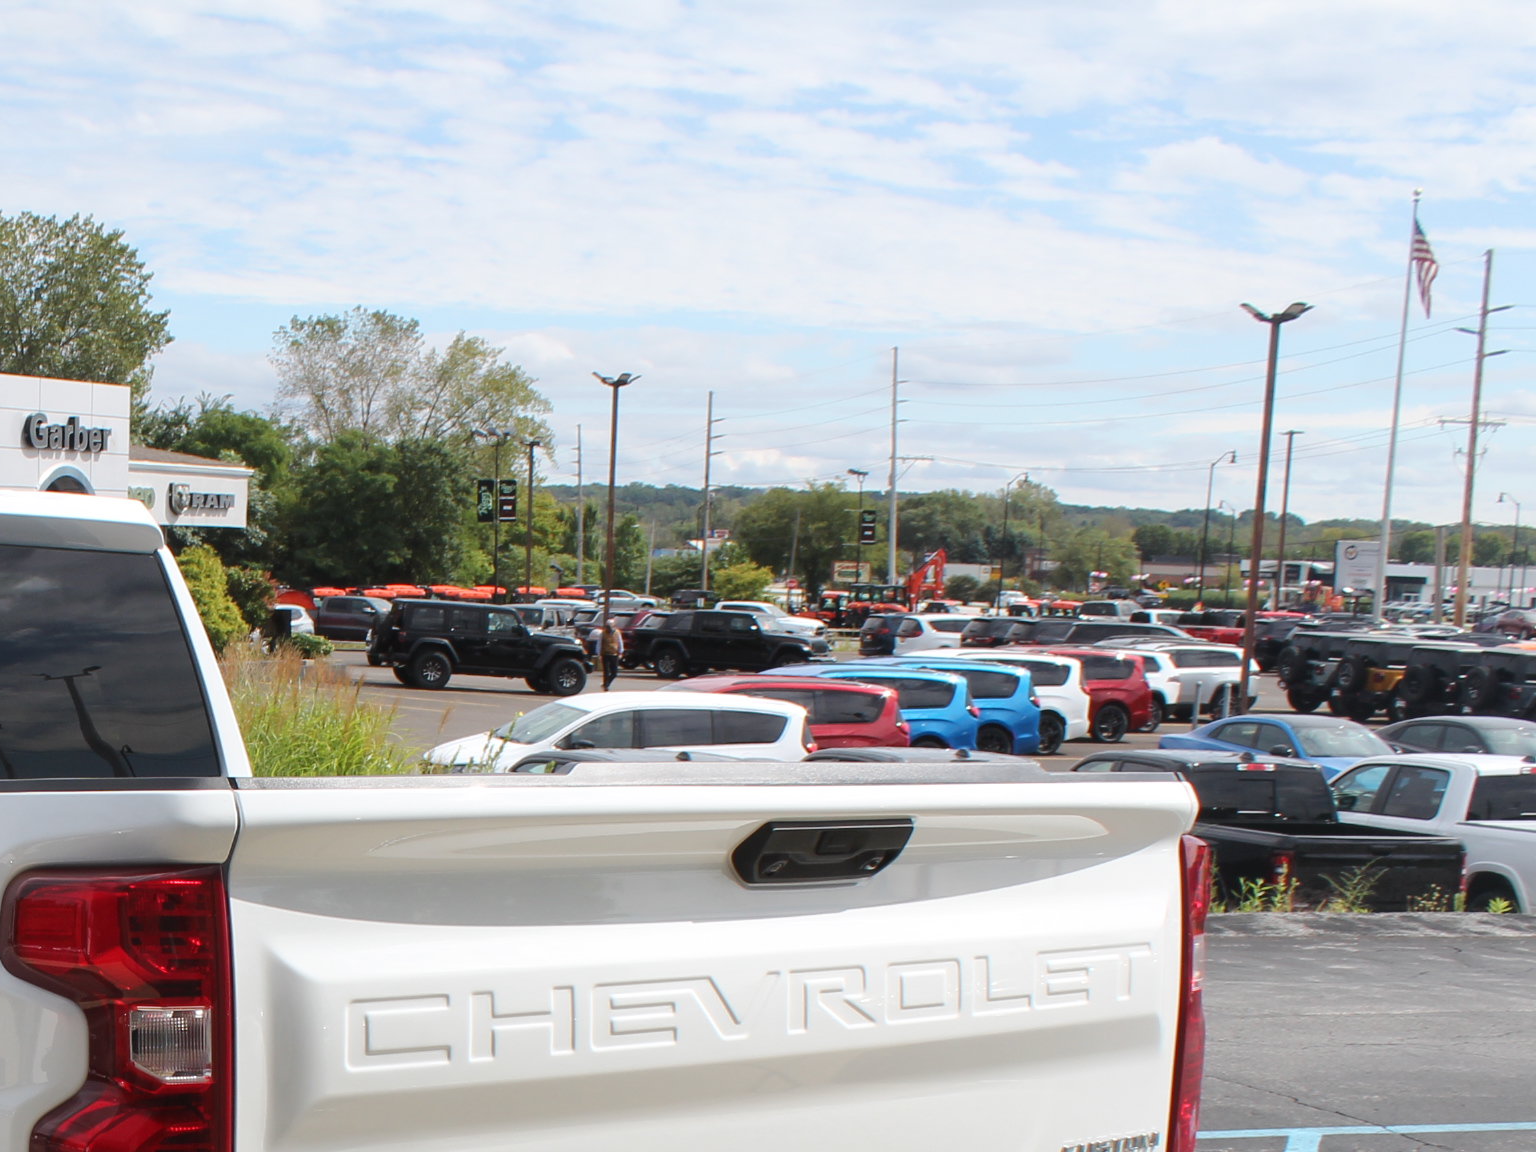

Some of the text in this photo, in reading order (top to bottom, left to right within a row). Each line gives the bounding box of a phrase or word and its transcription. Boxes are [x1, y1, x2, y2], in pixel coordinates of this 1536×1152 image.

[25, 412, 112, 452] Garber
[189, 492, 236, 509] RAM
[344, 942, 1154, 1074] CHEVROLET
